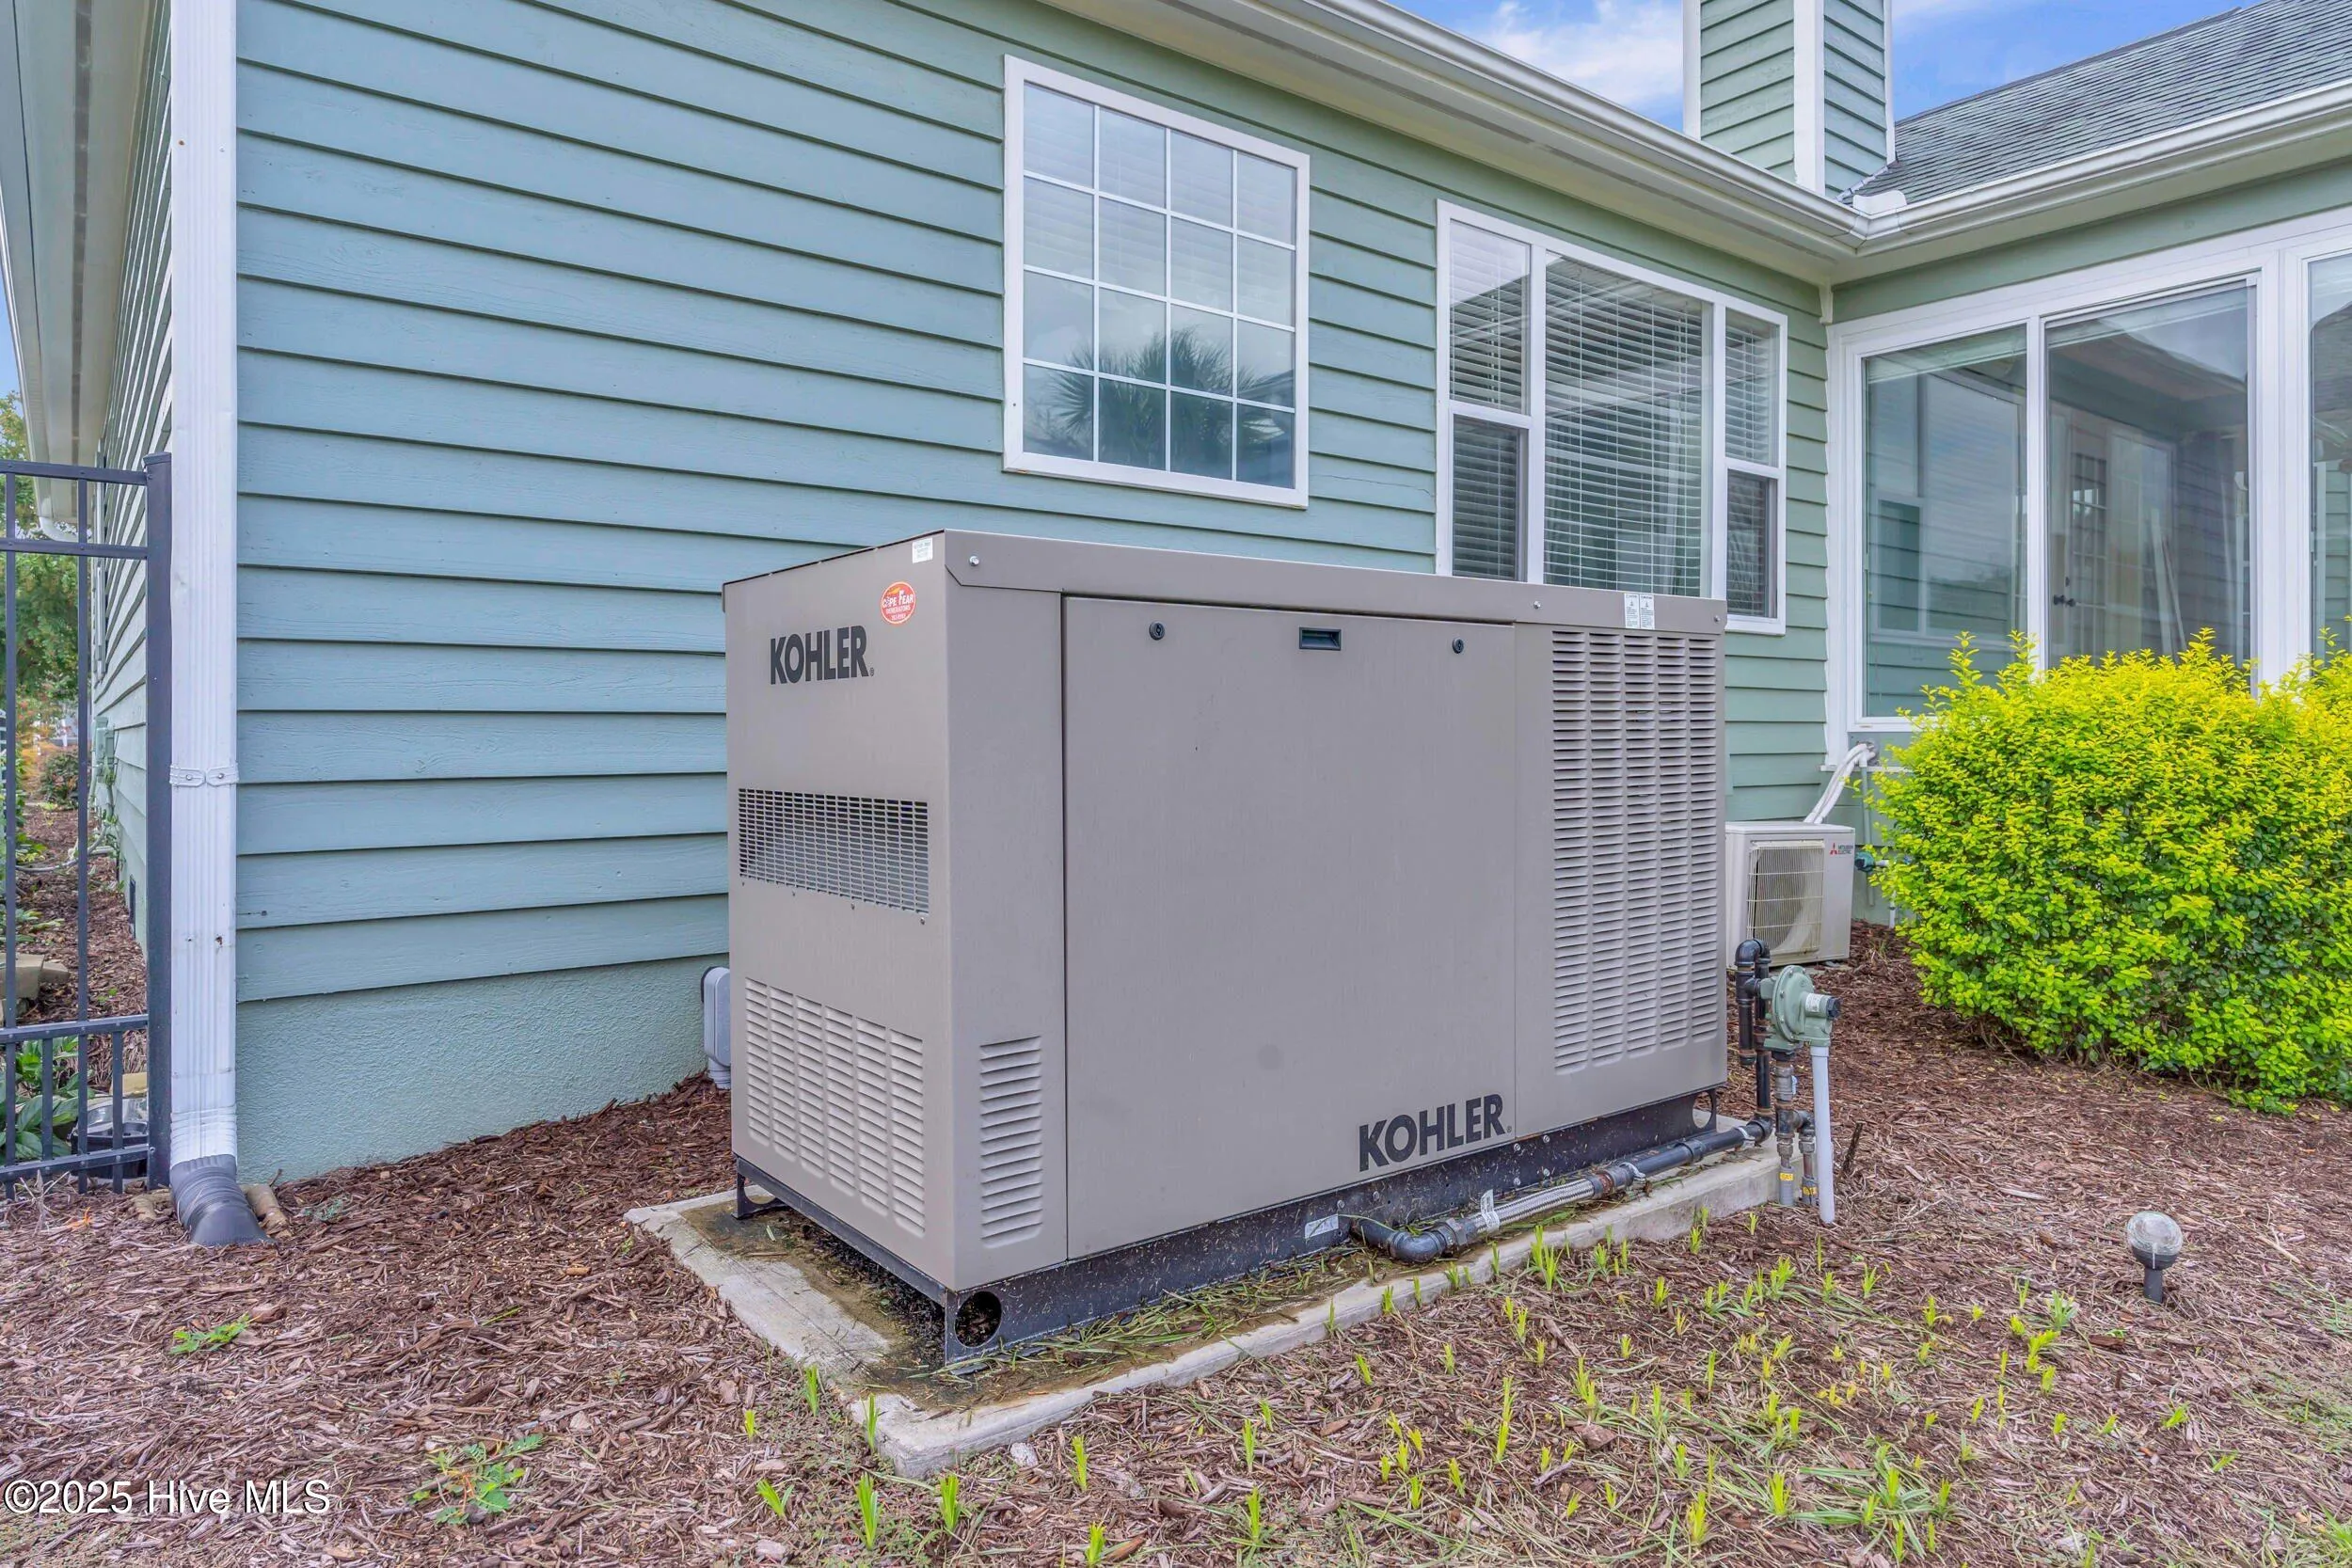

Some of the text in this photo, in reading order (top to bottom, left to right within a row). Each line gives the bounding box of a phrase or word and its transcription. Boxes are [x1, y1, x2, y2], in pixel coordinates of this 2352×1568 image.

[898, 590, 914, 605] FEAR
[770, 626, 869, 685] KOHLER
[1359, 1093, 1505, 1172] KOHLER
